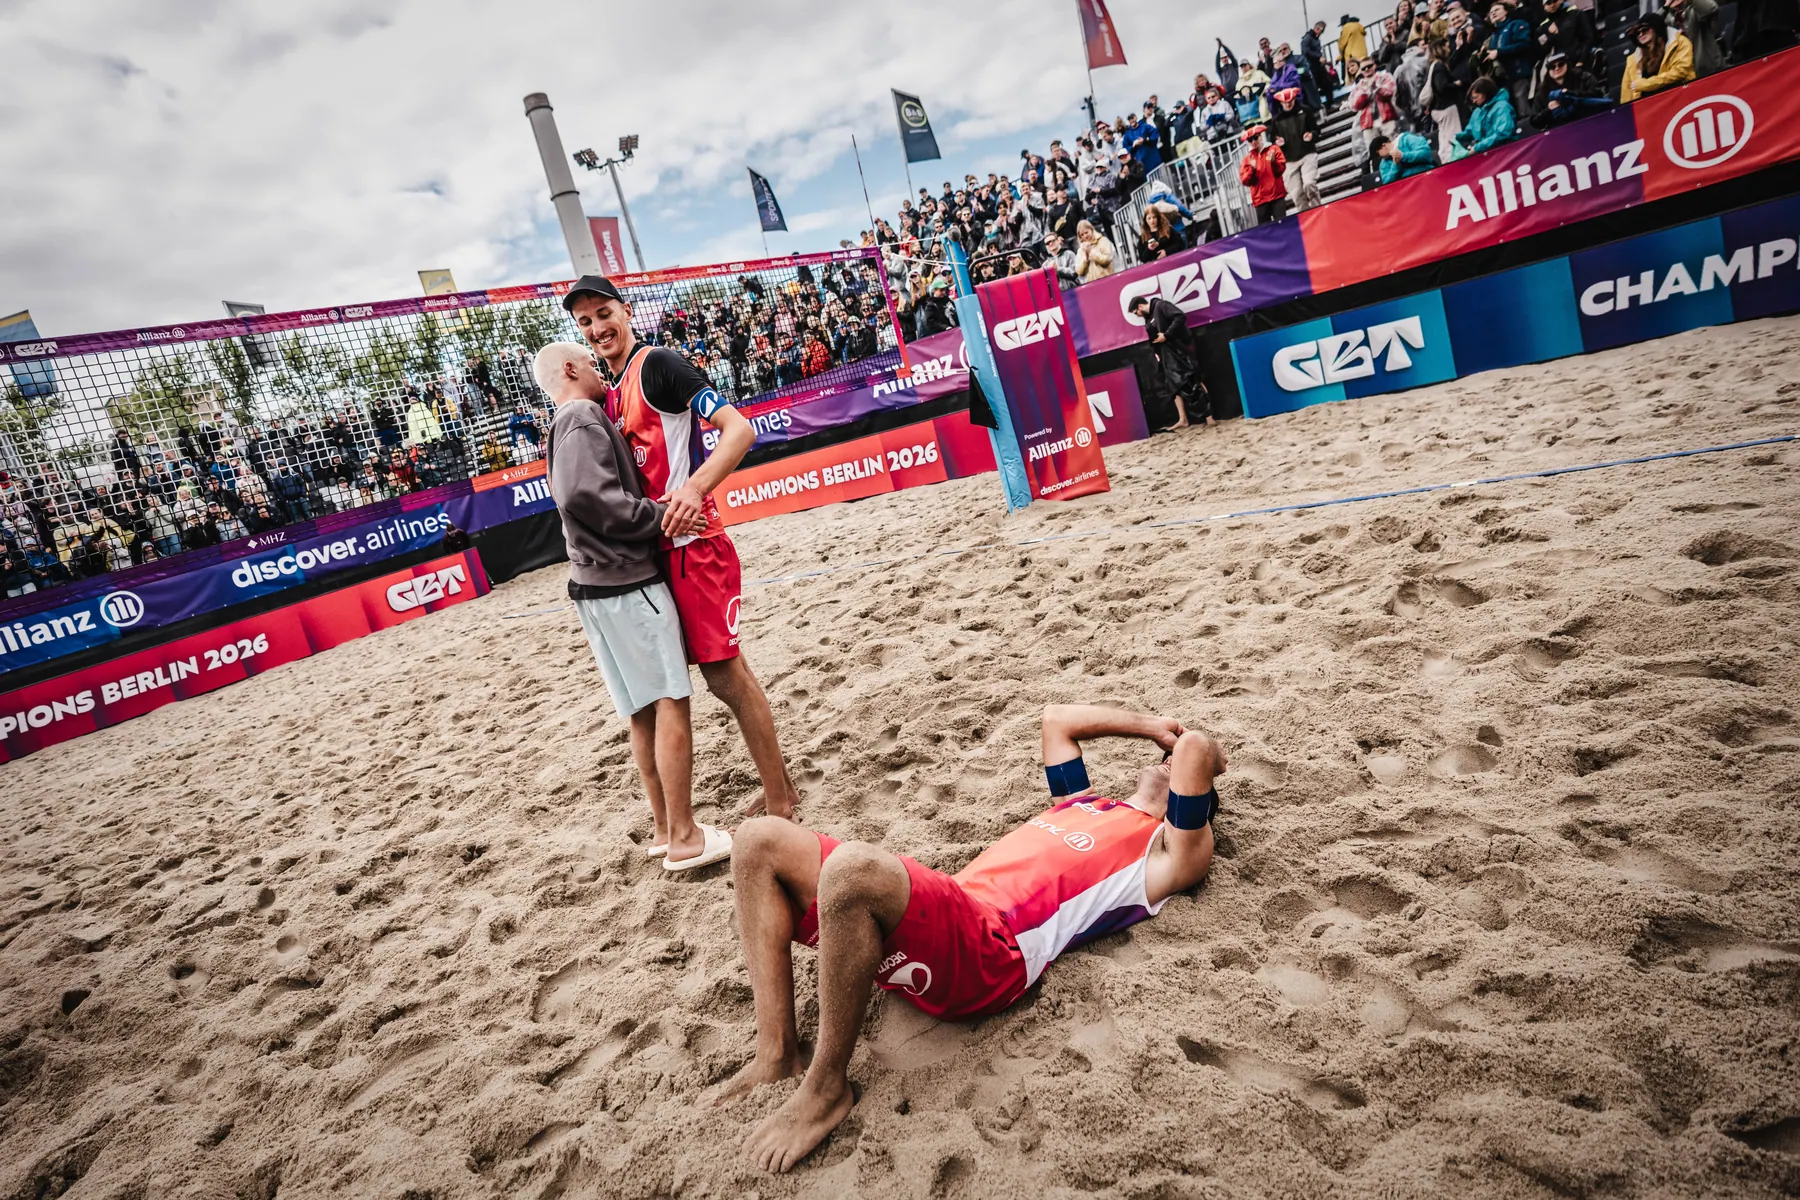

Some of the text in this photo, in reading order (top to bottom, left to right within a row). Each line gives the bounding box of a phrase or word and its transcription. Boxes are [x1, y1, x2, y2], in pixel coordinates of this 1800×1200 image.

[1445, 138, 1649, 231] Allianz
[537, 286, 557, 294] Allianz
[1119, 247, 1252, 326] GBT
[1580, 235, 1800, 317] CHAMP
[300, 312, 329, 323] Allianz
[424, 298, 449, 308] Allianz
[136, 330, 172, 342] Allianz
[993, 306, 1065, 352] GBT
[14, 341, 58, 357] GBT
[1272, 315, 1425, 392] GBT
[871, 353, 956, 398] Allianz
[1023, 428, 1045, 441] Powered
[1028, 436, 1075, 463] Allianz
[509, 467, 529, 479] MHZ
[726, 441, 939, 508] CHAMPIONS BERLIN 2026
[1040, 469, 1100, 496] discover.airlines
[511, 478, 552, 507] Alli
[231, 512, 452, 589] discover.airlines
[259, 531, 287, 547] MHZ
[387, 564, 466, 612] GBT
[0, 633, 270, 741] PIONS BERLIN 2026
